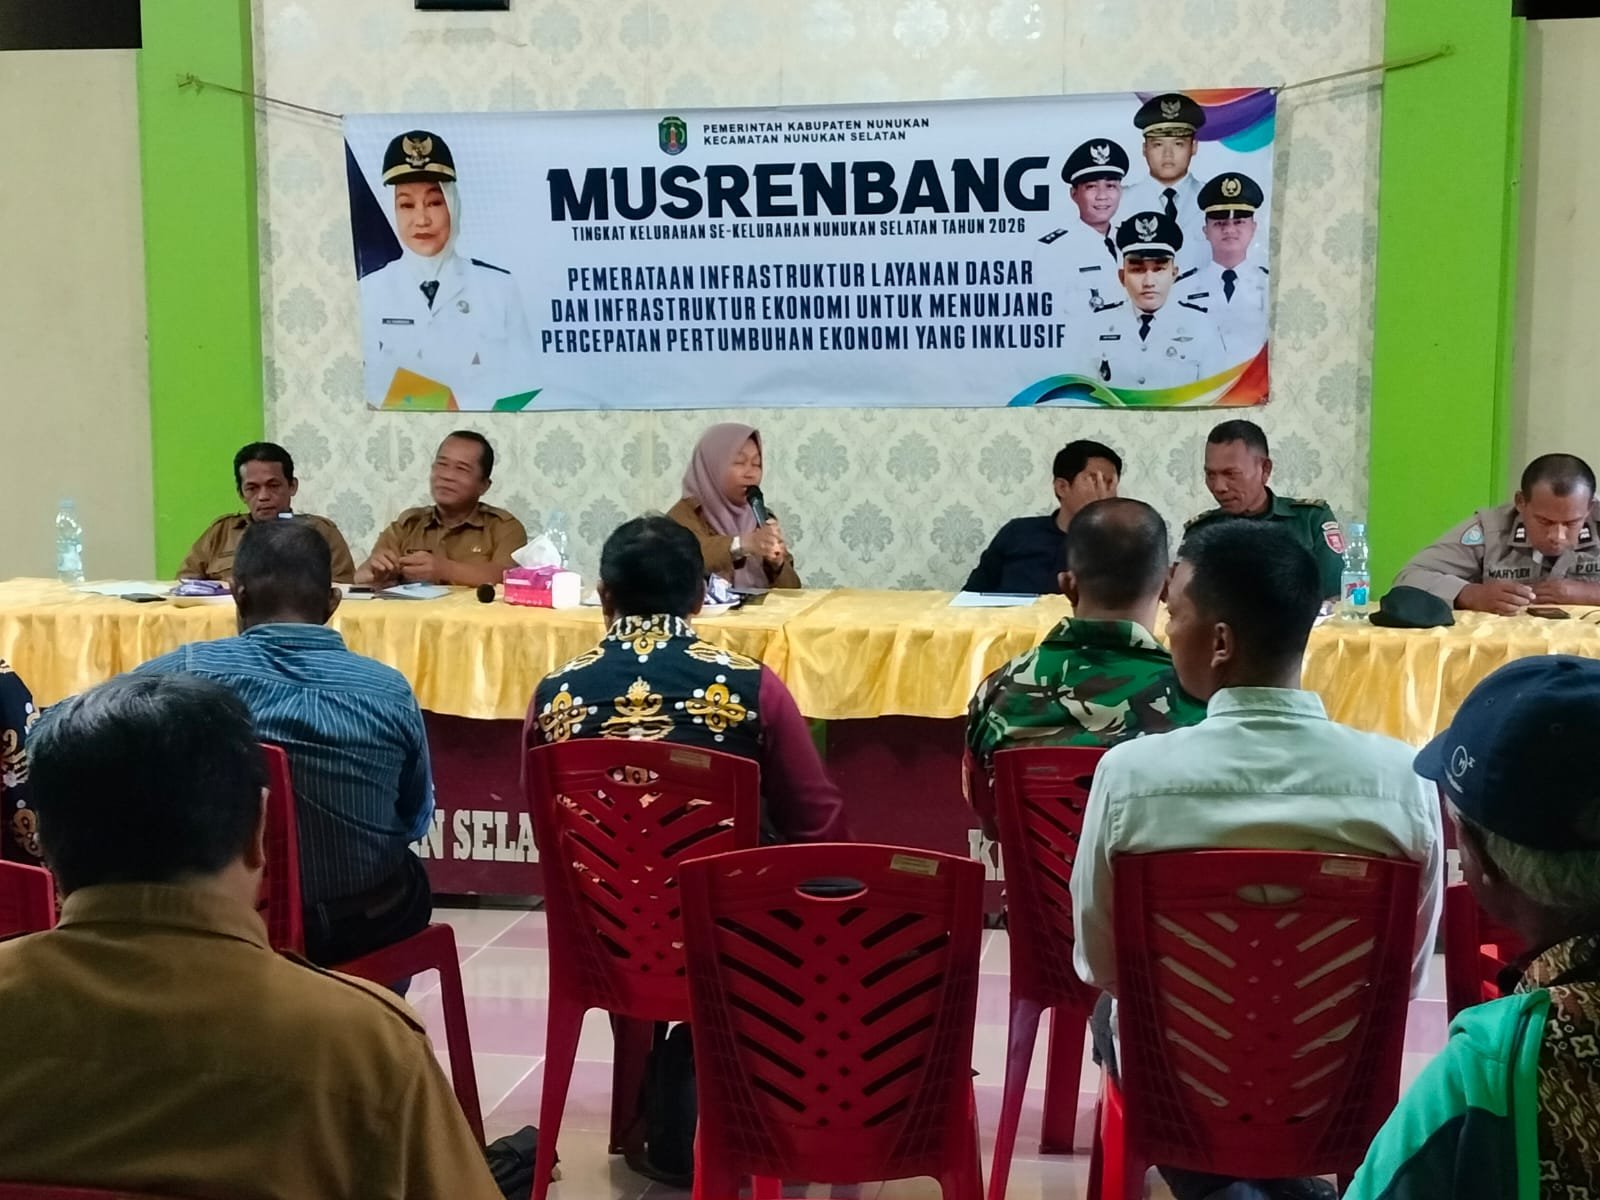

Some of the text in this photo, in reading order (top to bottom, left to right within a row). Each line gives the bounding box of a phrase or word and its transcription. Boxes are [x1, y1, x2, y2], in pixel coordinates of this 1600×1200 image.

[703, 118, 930, 134] PEMERINTAH KABUPATEN NUNUKAN
[703, 130, 906, 145] KECAMATAN NUNUKAN SELATAN
[546, 156, 1050, 221] MUSRENBANG
[571, 218, 1025, 241] TINGKAT KELURAHAN SE-KELURAHAN NUNUKAN SELATAN TAHUN 2026
[568, 260, 1032, 291] PEMERATAAN INFRASTRUKTUR LAYANAN DASAR
[552, 292, 1052, 322] DAN INFRASTRUKTUR EKONOMI UNTUK MENUNJANG
[541, 323, 1065, 353] PERCEPATAN PERTUMBUHAN EKONOMI YANG INKLUSIF
